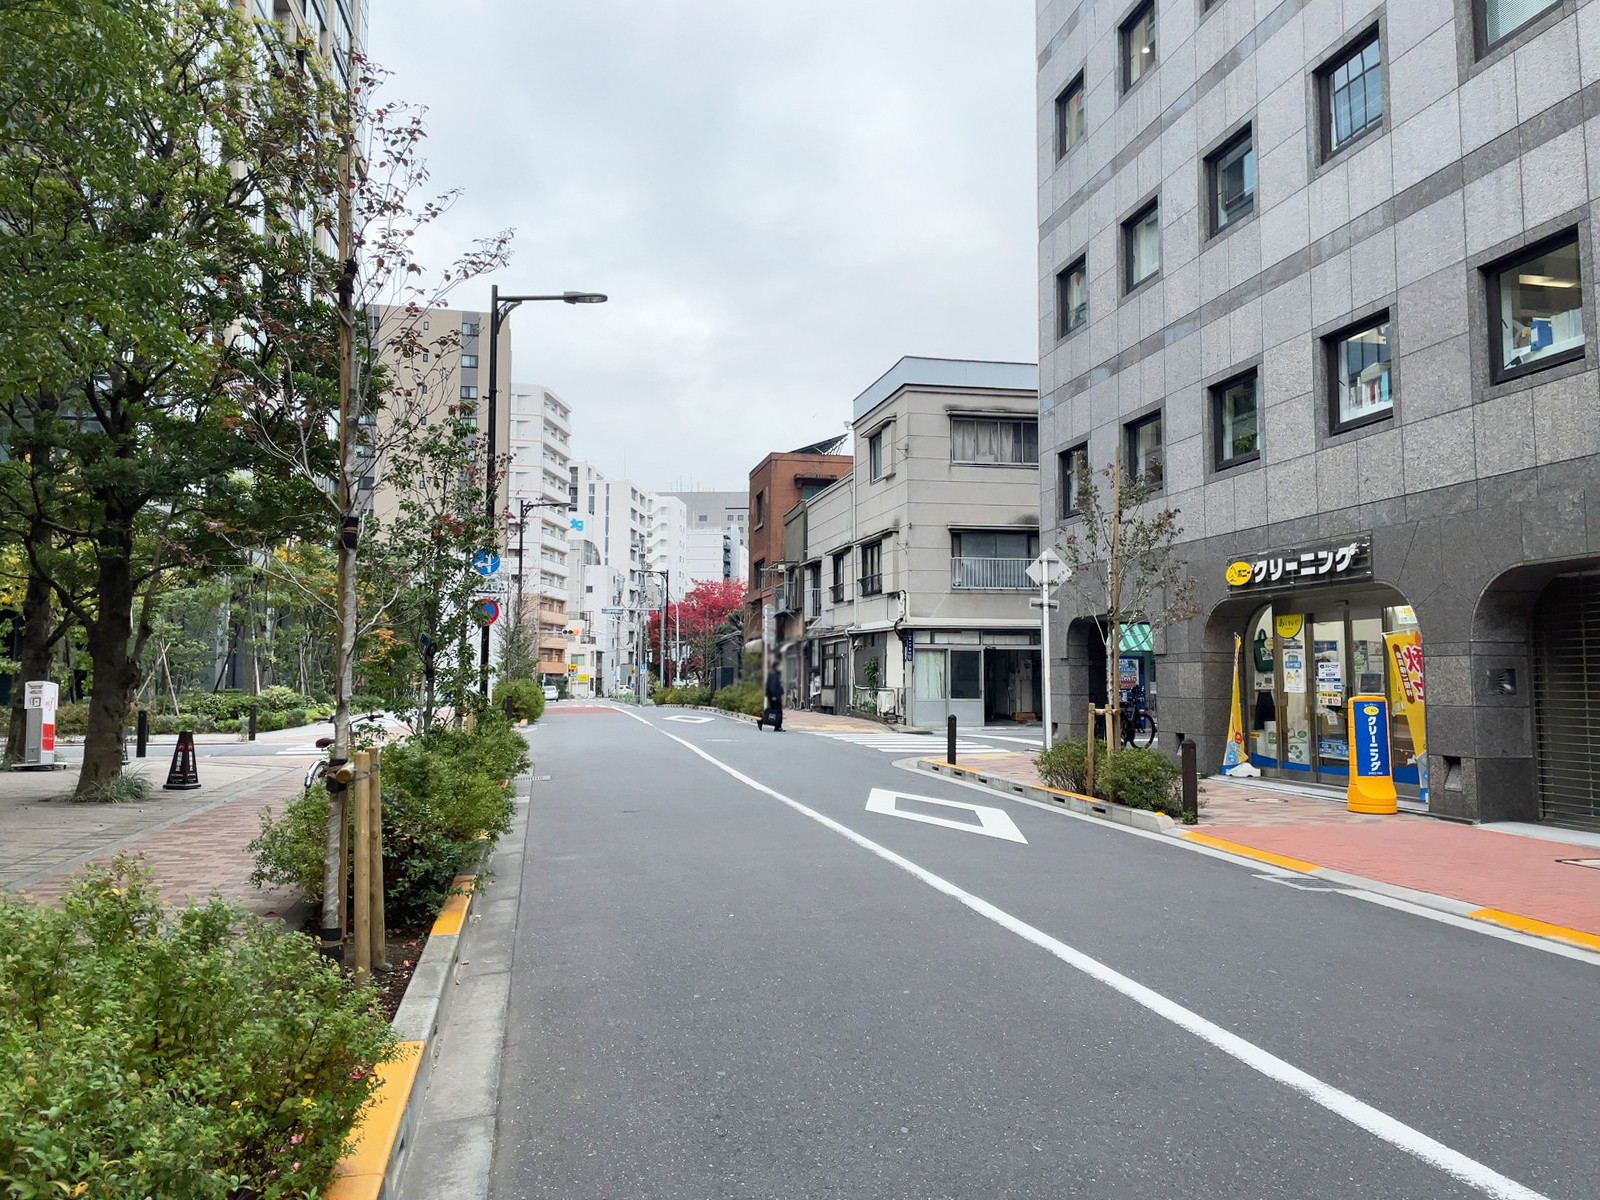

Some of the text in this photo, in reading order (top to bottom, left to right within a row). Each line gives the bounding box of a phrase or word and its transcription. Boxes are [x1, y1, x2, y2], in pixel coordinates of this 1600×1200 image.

[1254, 542, 1360, 584] クリーニング
[1367, 716, 1382, 772] クリーニング
